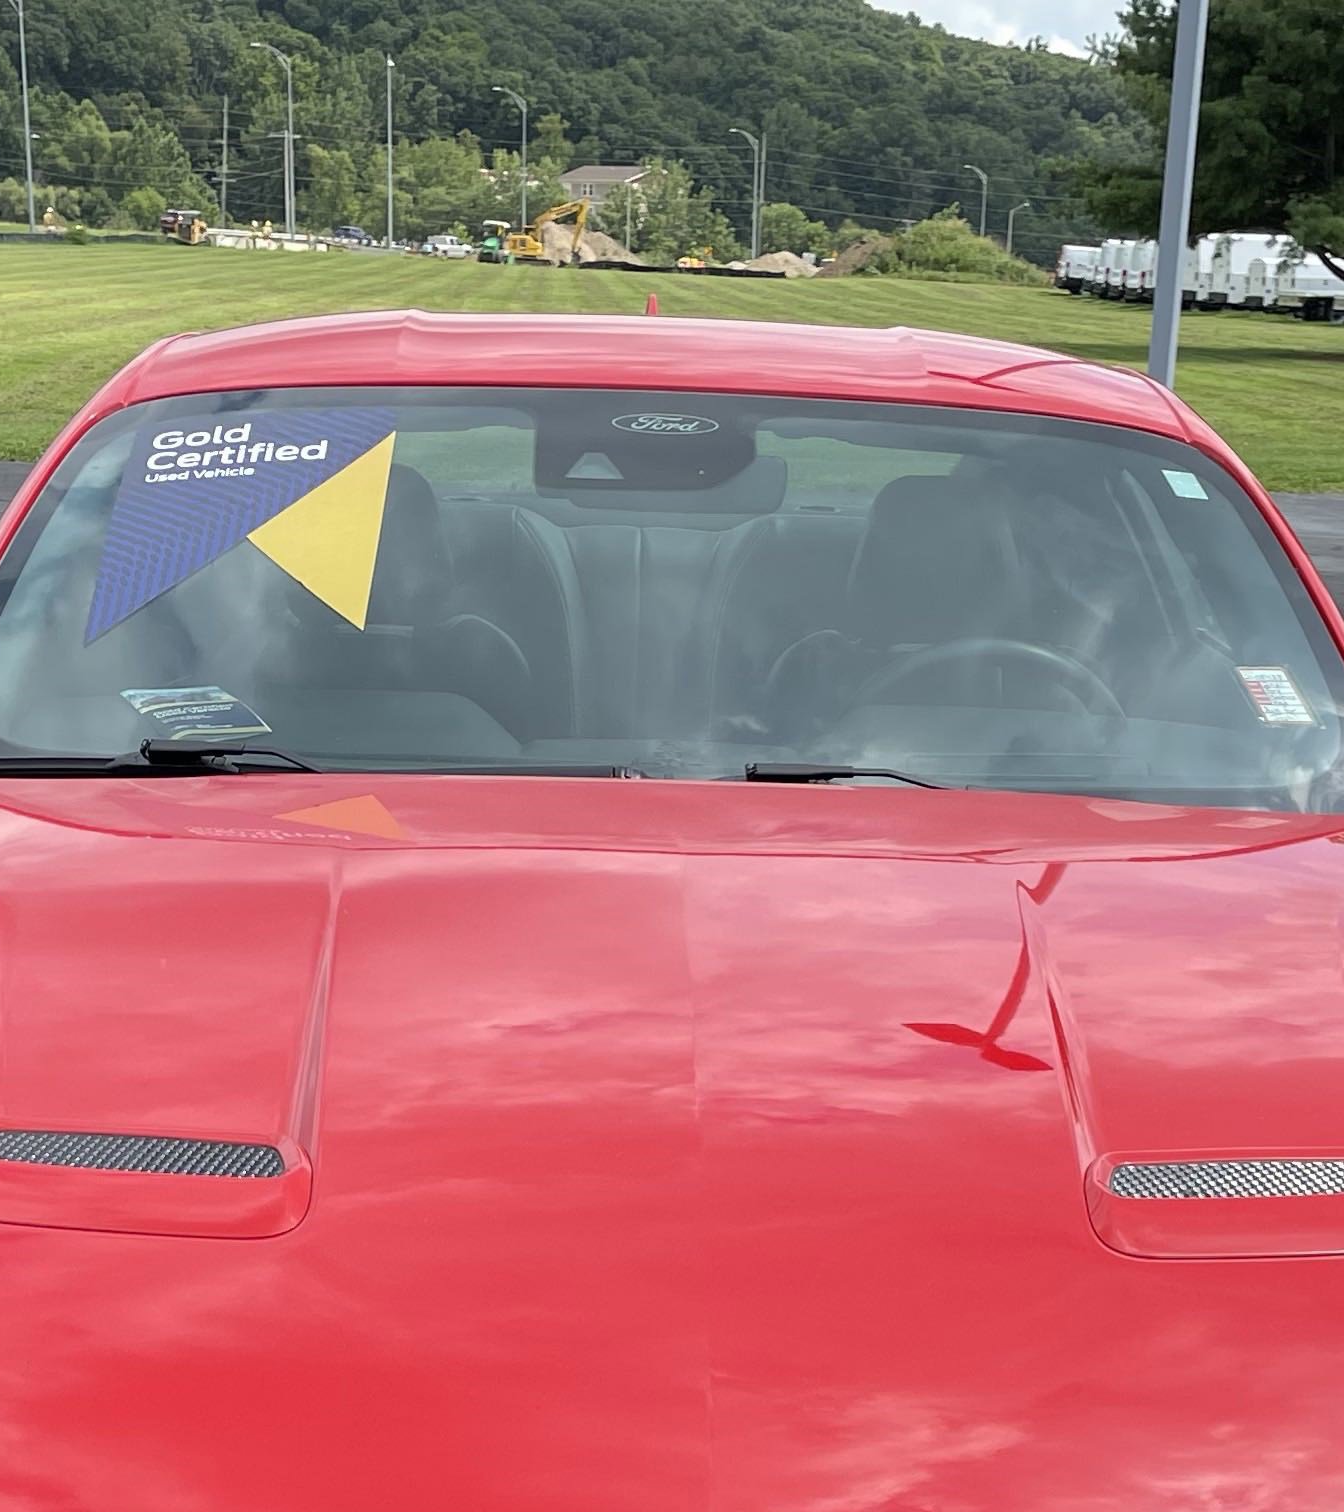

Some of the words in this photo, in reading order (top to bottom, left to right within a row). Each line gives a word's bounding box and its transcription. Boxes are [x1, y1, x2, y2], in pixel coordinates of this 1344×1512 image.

[630, 415, 699, 432] Ford
[153, 423, 252, 450] Gold
[146, 440, 329, 470] Certified
[145, 470, 189, 483] Used
[193, 466, 256, 479] Vehicle
